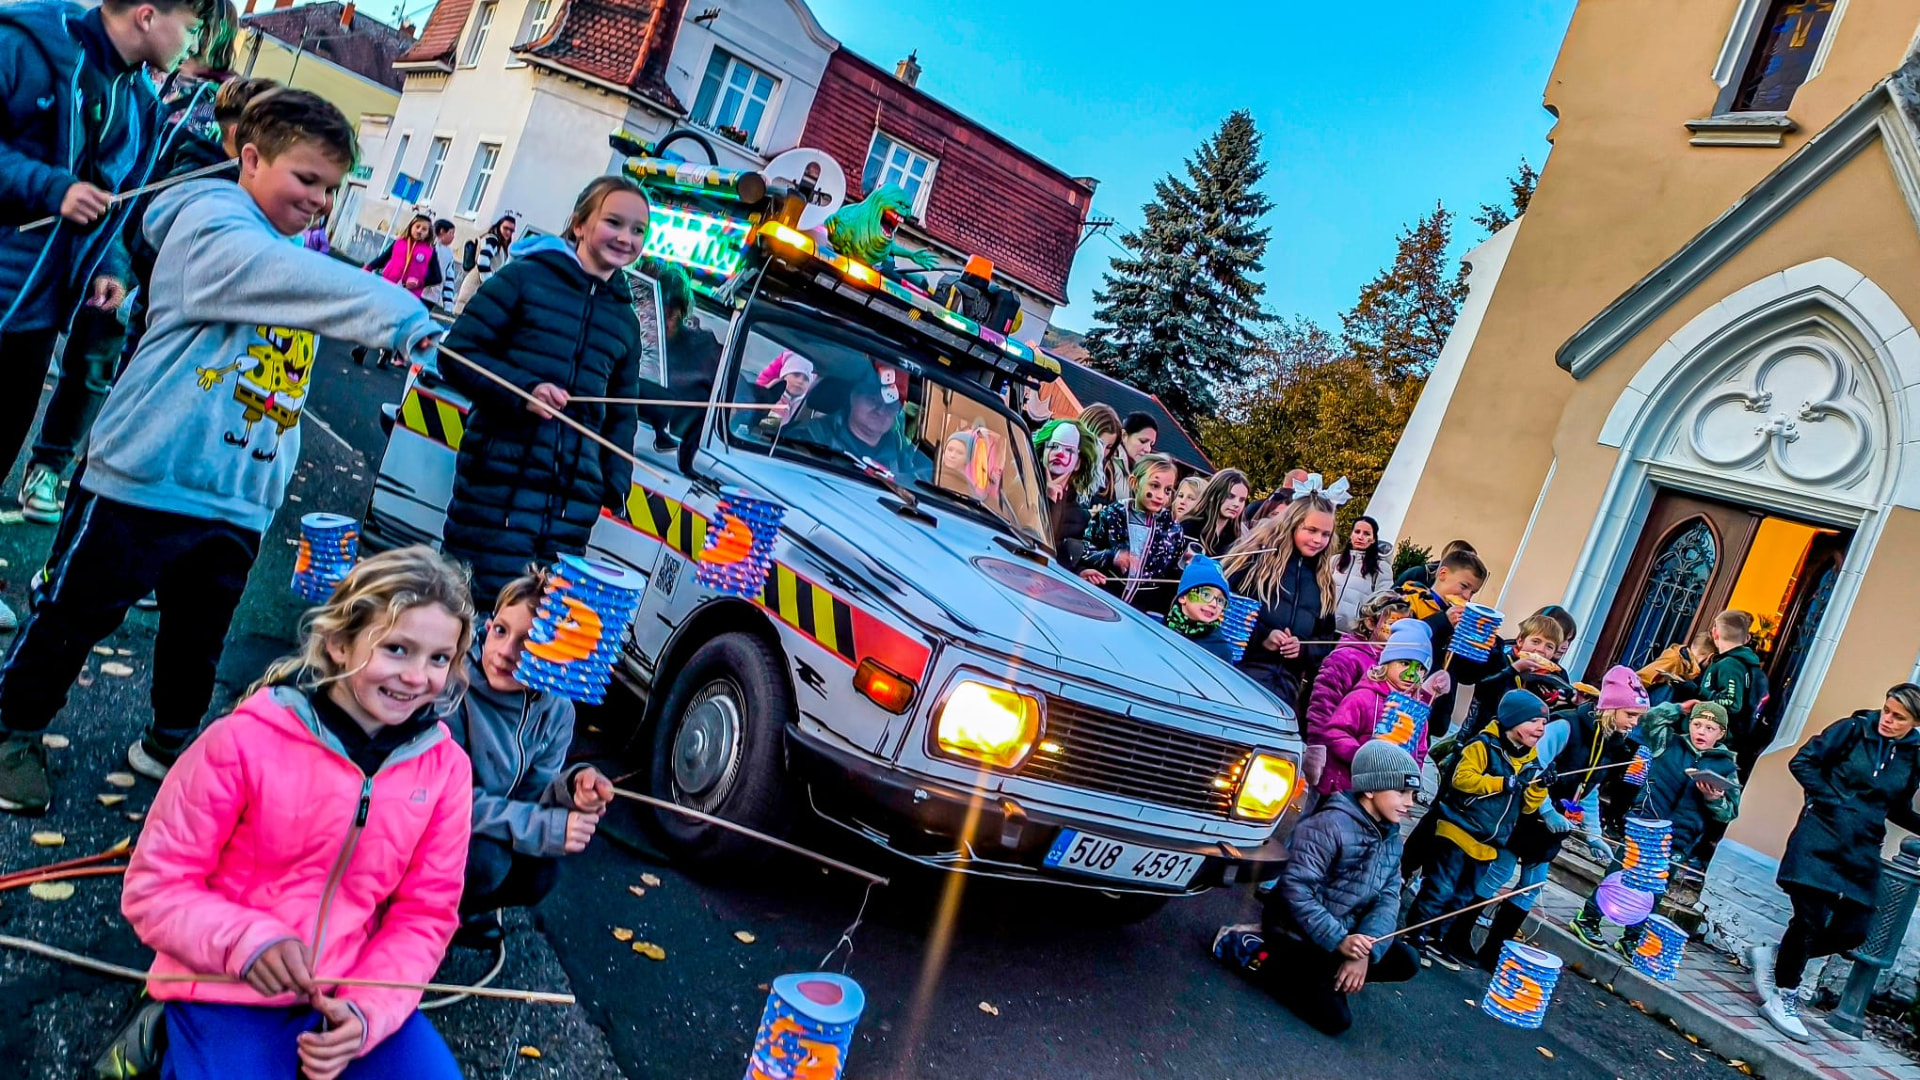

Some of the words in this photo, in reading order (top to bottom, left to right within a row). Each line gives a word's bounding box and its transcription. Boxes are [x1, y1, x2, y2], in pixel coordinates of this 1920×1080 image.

[1047, 849, 1062, 861] CZ
[1069, 836, 1123, 870] 5U8
[1131, 851, 1193, 882] 4591
